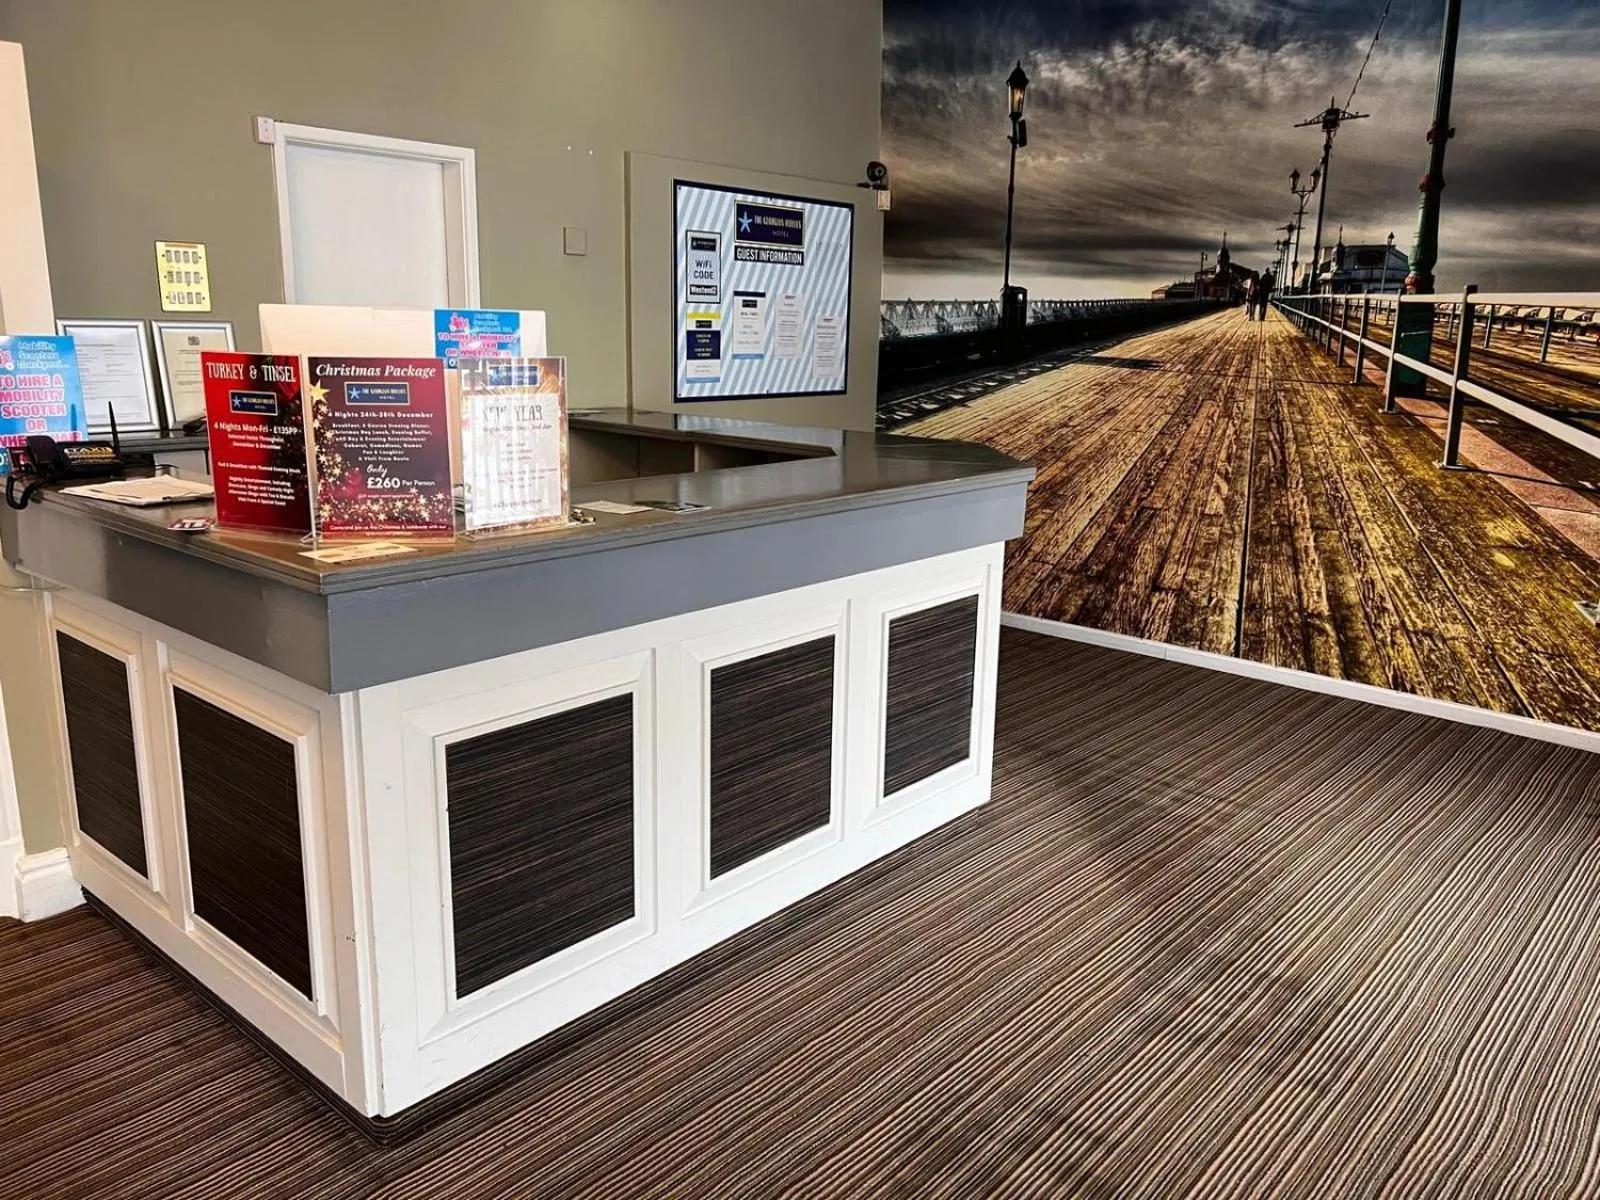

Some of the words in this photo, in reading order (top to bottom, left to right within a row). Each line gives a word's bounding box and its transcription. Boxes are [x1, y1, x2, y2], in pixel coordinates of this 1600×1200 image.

[737, 248, 758, 260] GUEST
[759, 250, 802, 264] INFORMATION
[694, 270, 714, 280] CODE
[206, 362, 244, 380] TURKEY
[249, 365, 257, 380] &
[261, 365, 296, 382] TINSEL
[316, 363, 381, 376] Christmas
[384, 364, 437, 379] Package
[17, 374, 50, 387] HIRE
[52, 374, 64, 387] A
[0, 388, 64, 402] MOBILITY
[1, 404, 66, 418] SCOOTER
[26, 418, 47, 432] OR
[220, 422, 241, 431] Nights
[243, 424, 268, 432] Mon-Fri
[367, 464, 387, 478] Only
[367, 477, 401, 489] £260
